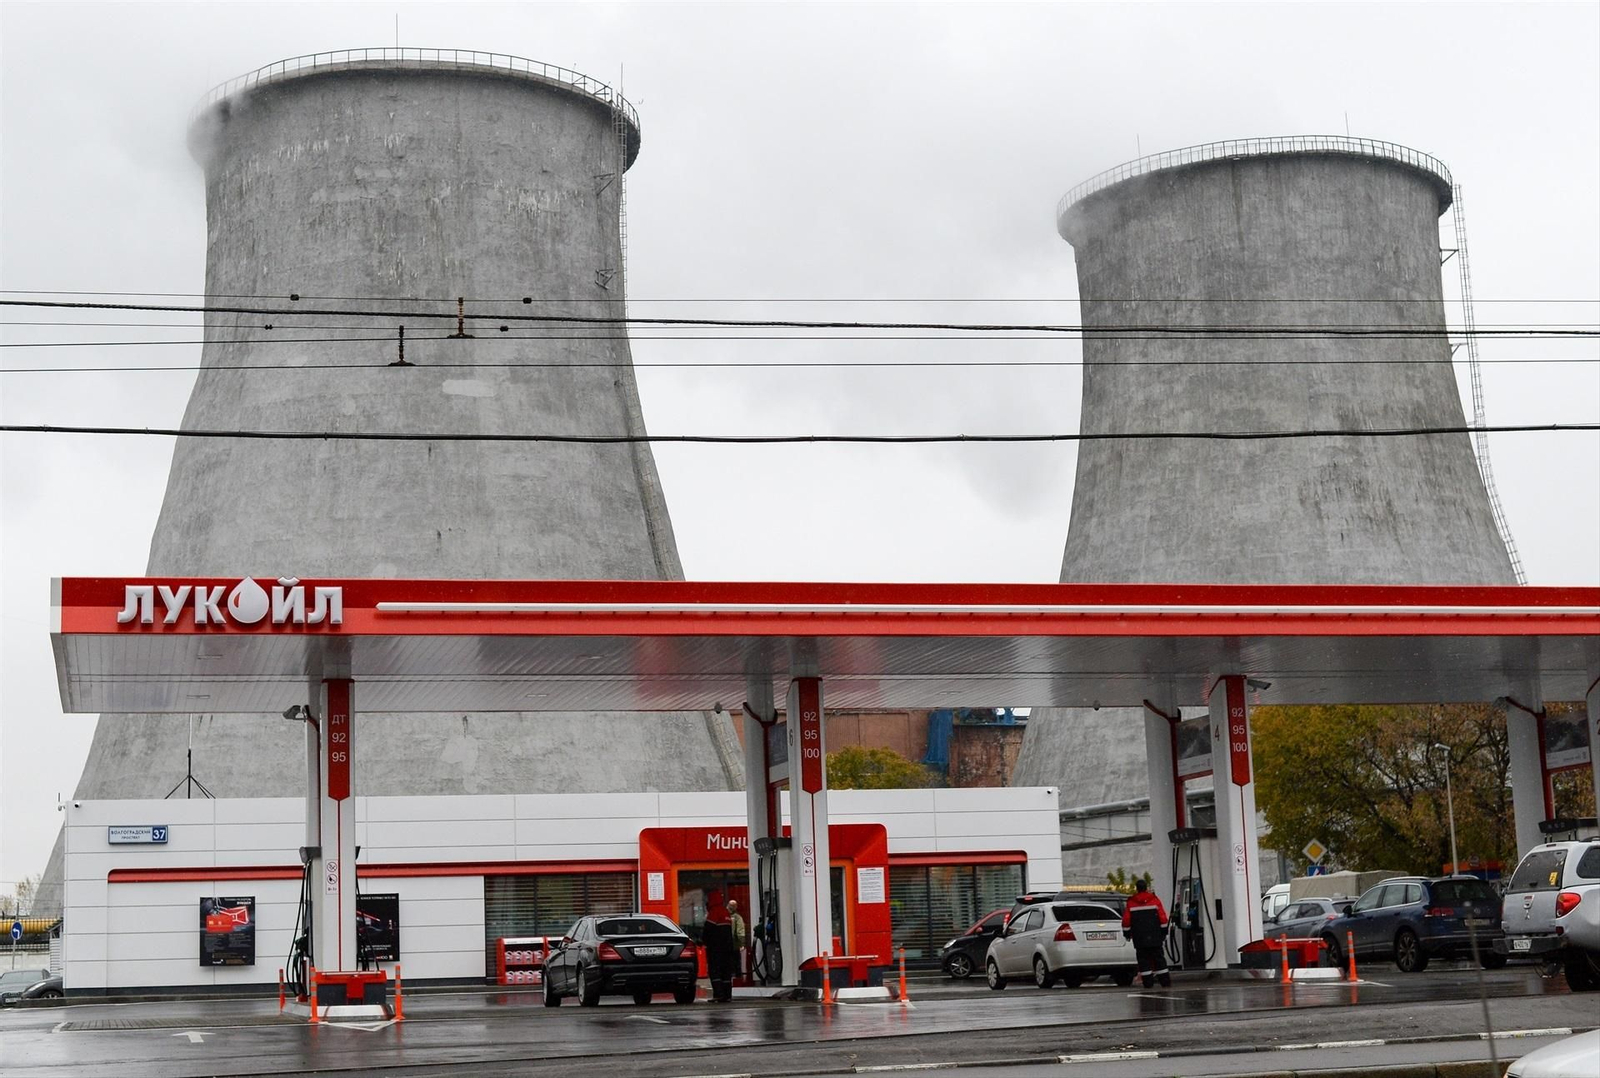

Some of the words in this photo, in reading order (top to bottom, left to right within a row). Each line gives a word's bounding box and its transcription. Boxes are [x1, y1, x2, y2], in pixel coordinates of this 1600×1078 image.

[117, 575, 343, 624] ЛУКОЙЛ
[803, 711, 817, 722] 92
[1231, 707, 1244, 718] 92
[331, 714, 346, 725] ДТ
[804, 729, 818, 740] 95
[1214, 724, 1220, 742] 4
[1232, 724, 1246, 735] 95
[331, 732, 346, 743] 92
[789, 728, 794, 747] 6
[803, 748, 820, 758] 100
[1232, 742, 1248, 753] 100
[331, 751, 347, 762] 95
[152, 829, 166, 840] 37
